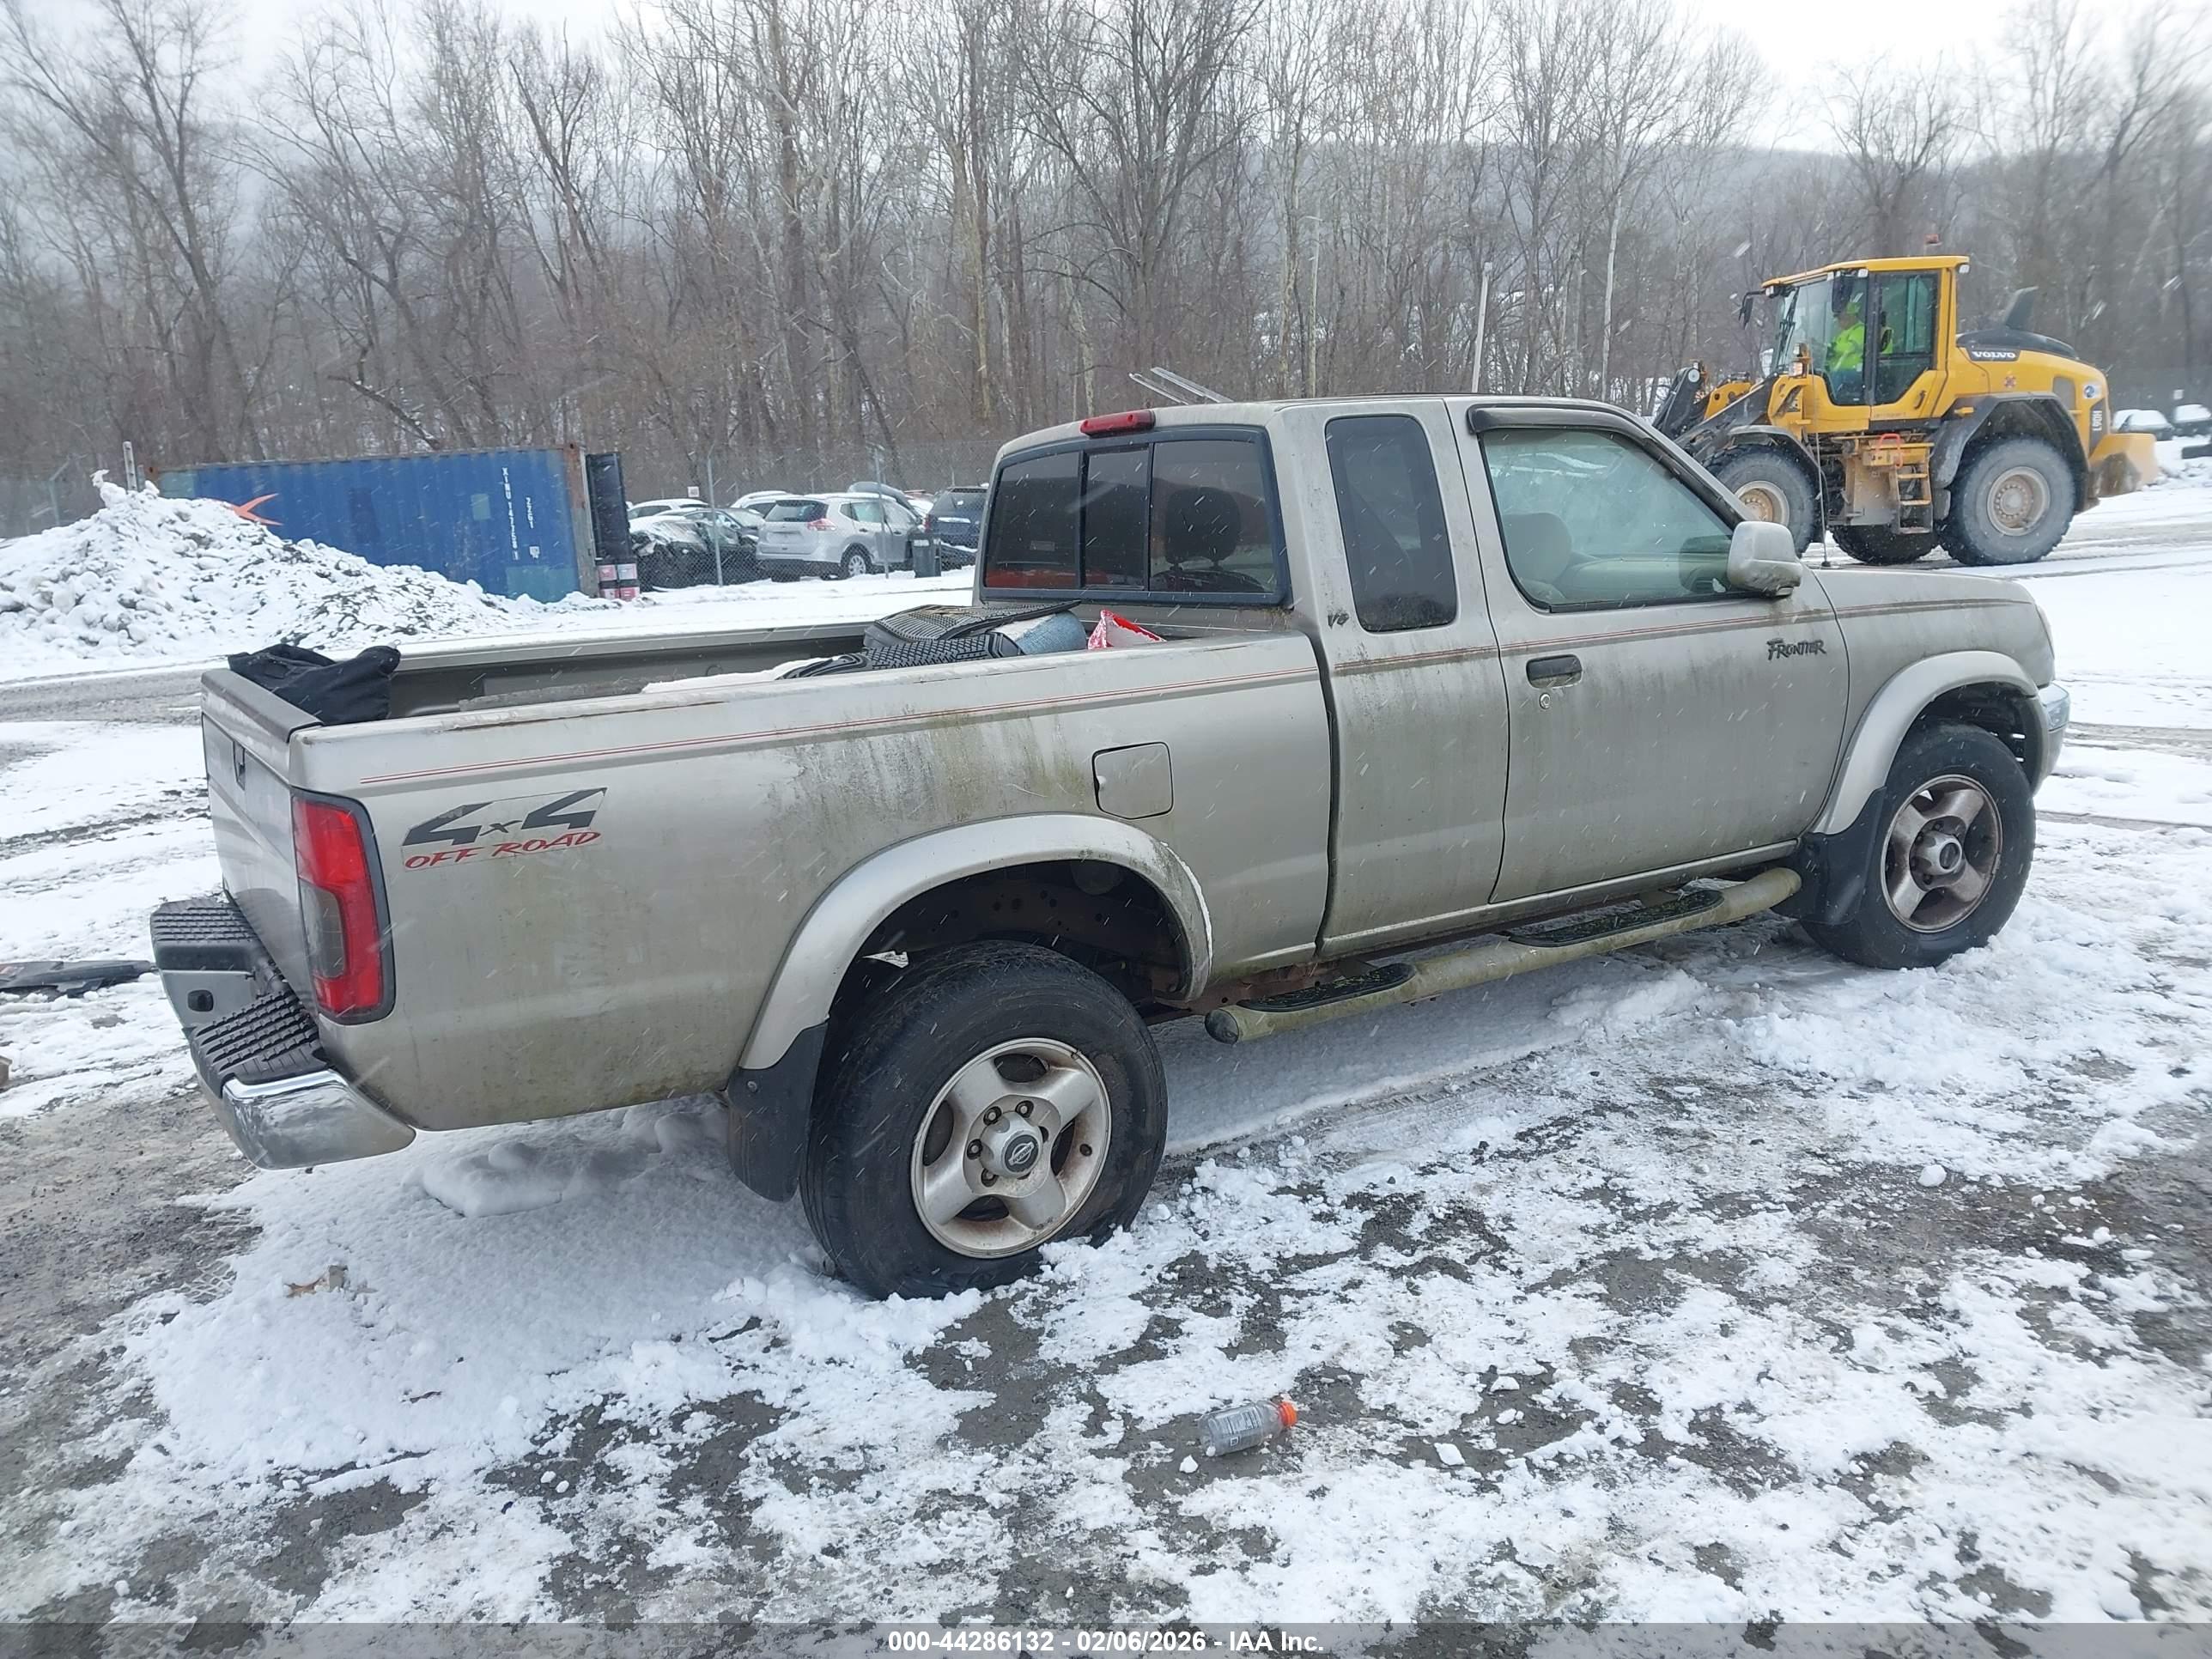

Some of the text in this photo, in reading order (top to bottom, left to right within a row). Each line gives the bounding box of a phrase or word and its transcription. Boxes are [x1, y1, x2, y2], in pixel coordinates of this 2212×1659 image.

[1327, 611, 1350, 629] V6
[404, 830, 602, 870] OFF ROAD
